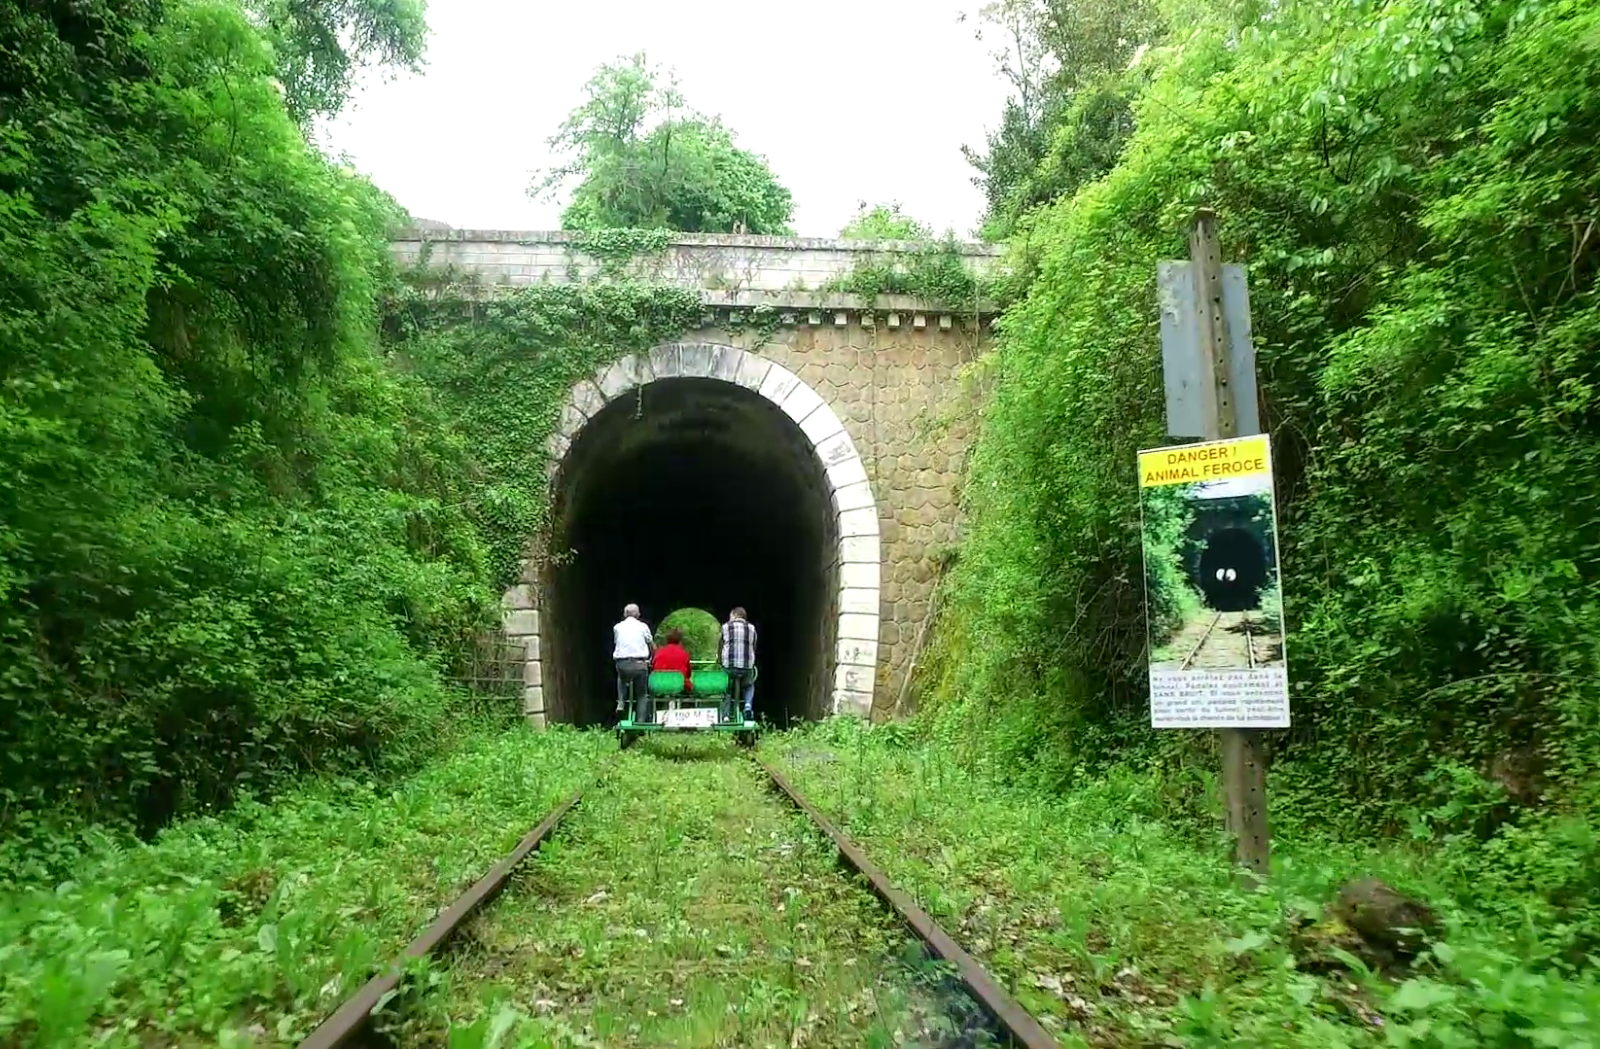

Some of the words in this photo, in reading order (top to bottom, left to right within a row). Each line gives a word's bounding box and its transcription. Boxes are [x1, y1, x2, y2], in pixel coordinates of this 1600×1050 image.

[1167, 447, 1228, 465] DANGER
[1145, 466, 1199, 483] ANIMAL
[1203, 458, 1265, 475] FEROCE
